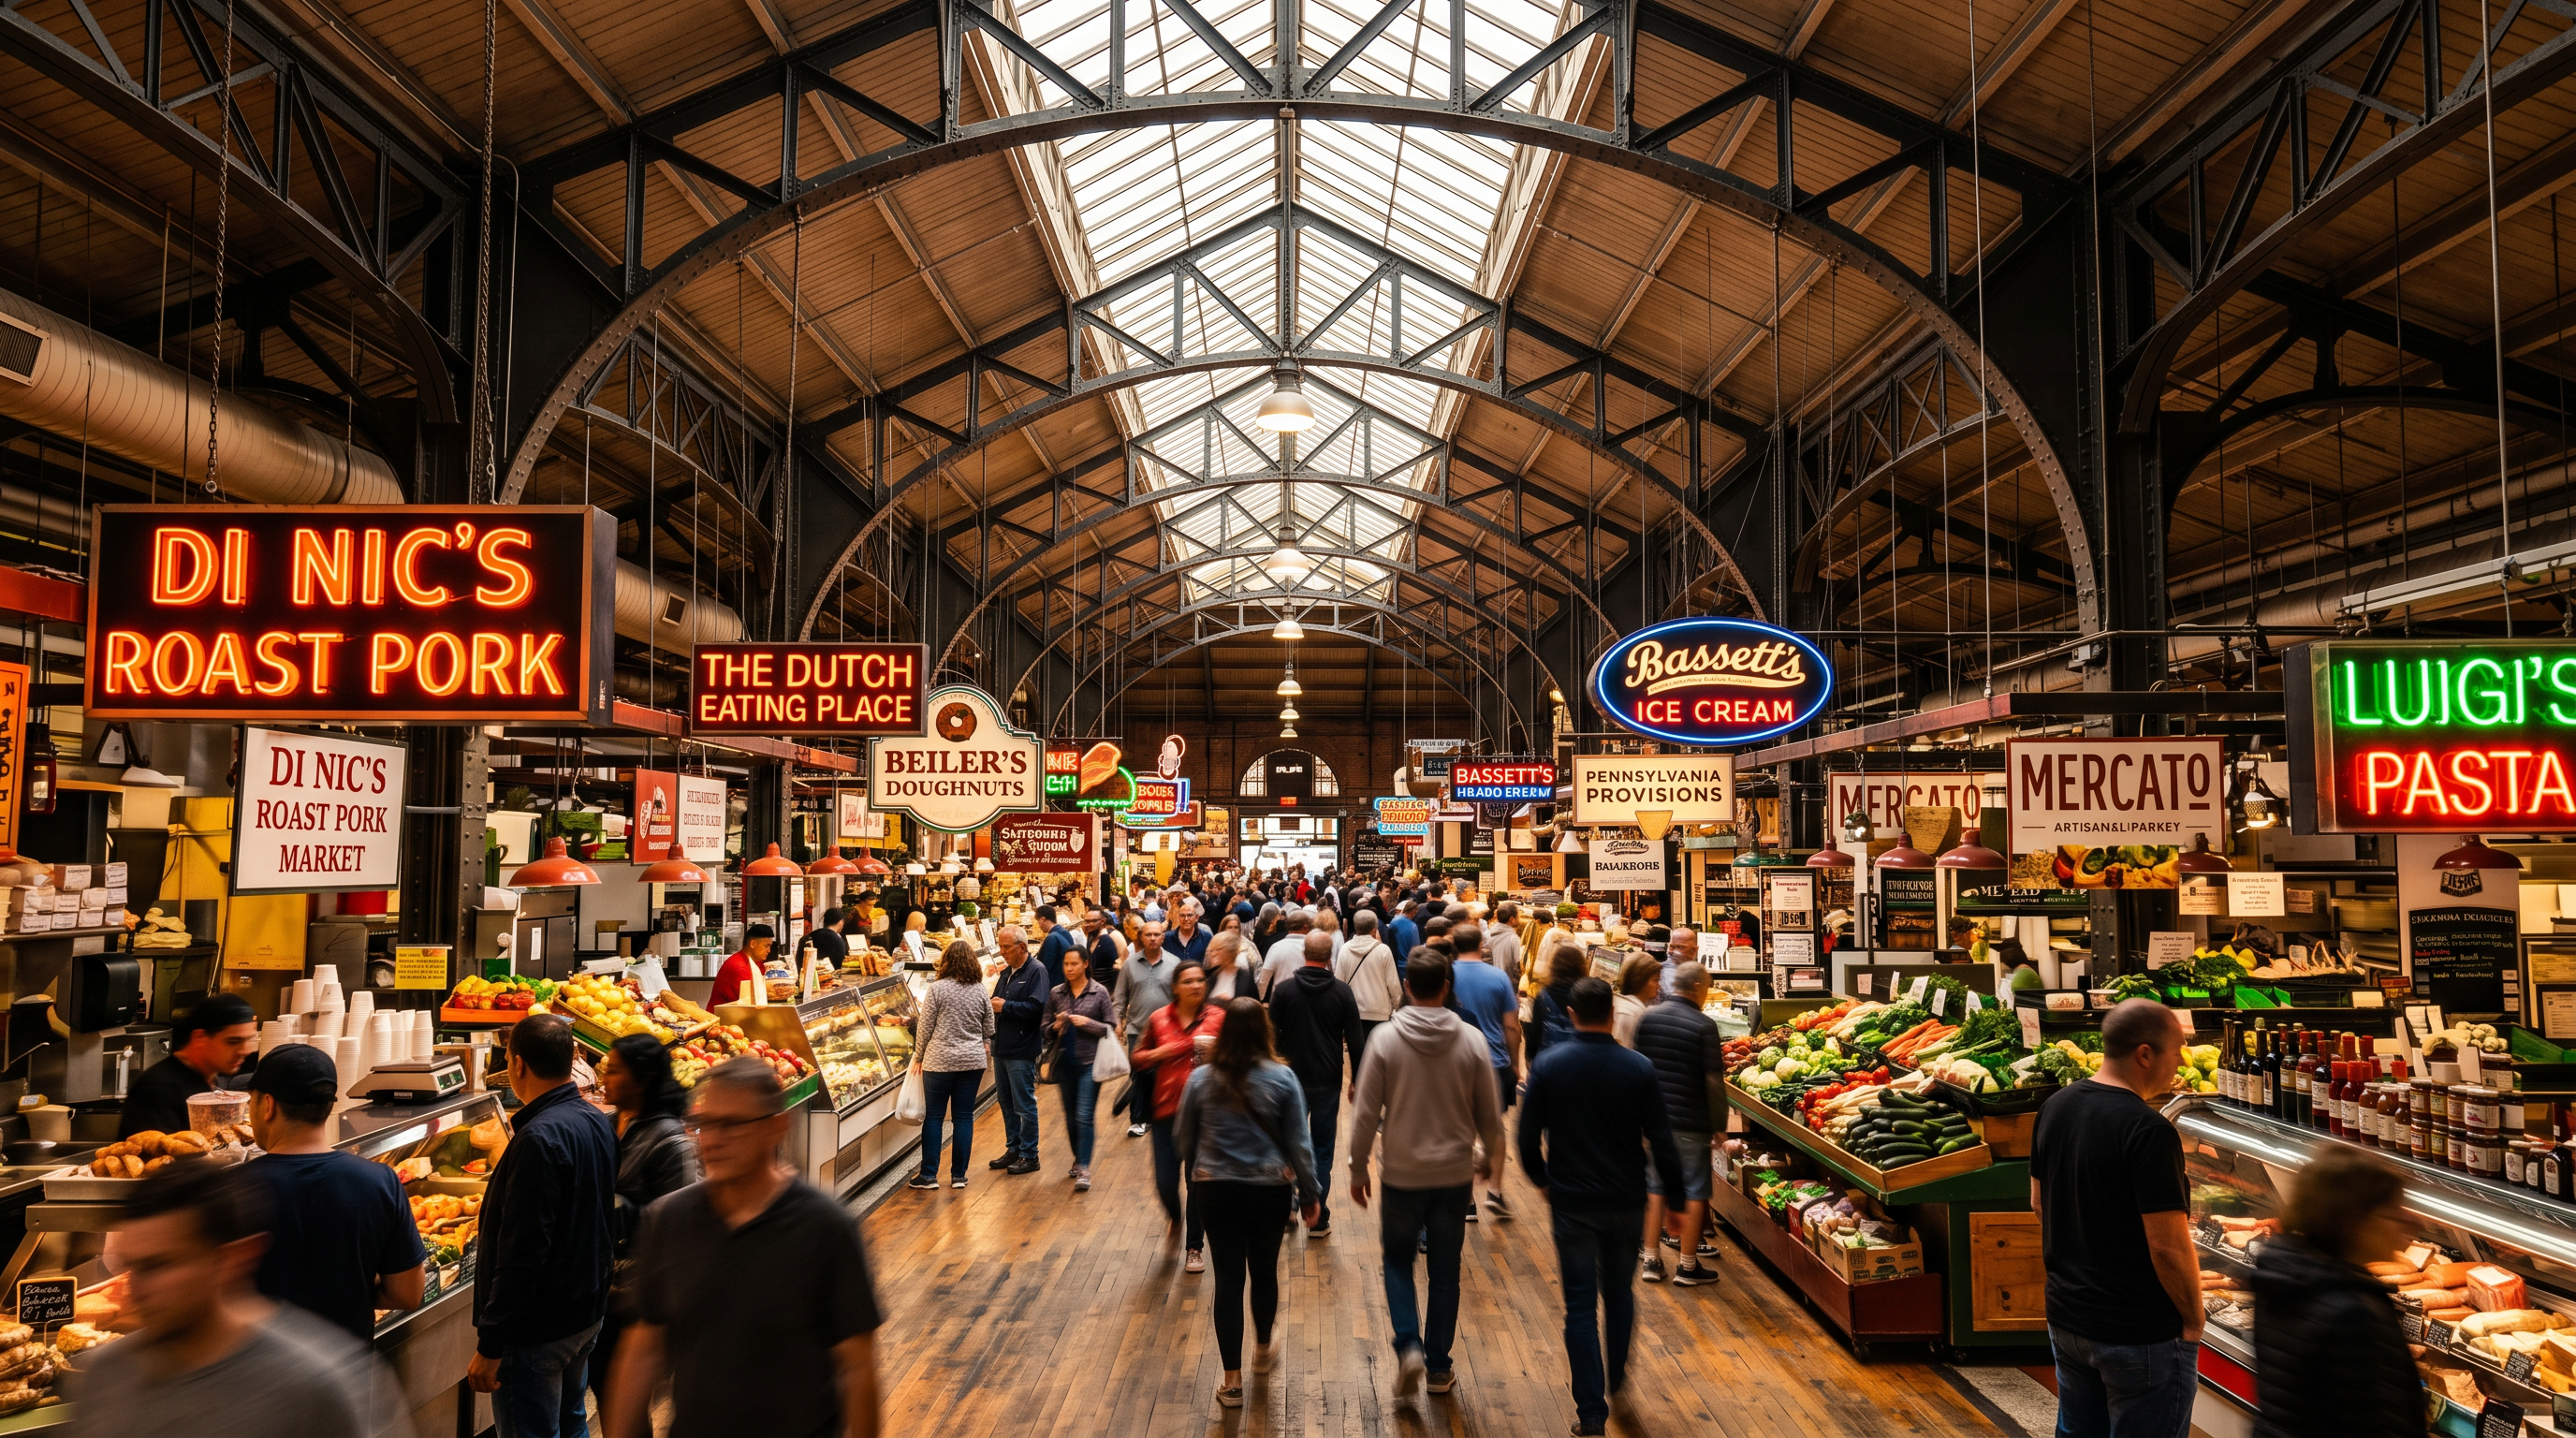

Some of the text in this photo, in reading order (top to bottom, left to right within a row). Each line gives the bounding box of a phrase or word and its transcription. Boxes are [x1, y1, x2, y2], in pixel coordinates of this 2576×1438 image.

[152, 521, 535, 608] DI NIC'S
[105, 630, 565, 697] ROAST PORK
[701, 653, 913, 688] THE DUTCH
[1624, 640, 1807, 689] Bassett's
[2343, 655, 2576, 726] LUIGI'S
[700, 694, 806, 723] EATING
[817, 694, 913, 723] PLACE
[1637, 700, 1793, 723] ICE CREAM
[269, 746, 388, 795] DI NIC'S
[884, 750, 1028, 774] BEILER'S
[1456, 765, 1554, 784] BASSETT'S
[1586, 770, 1722, 783] PENNSYLVANIA
[885, 780, 1026, 797] DOUGHNUTS
[1586, 786, 1722, 803] PROVISIONS
[2020, 753, 2212, 812] MERCATO
[2365, 750, 2576, 816] PASTA
[255, 799, 388, 833] ROAST PORK
[278, 844, 366, 873] MARKET
